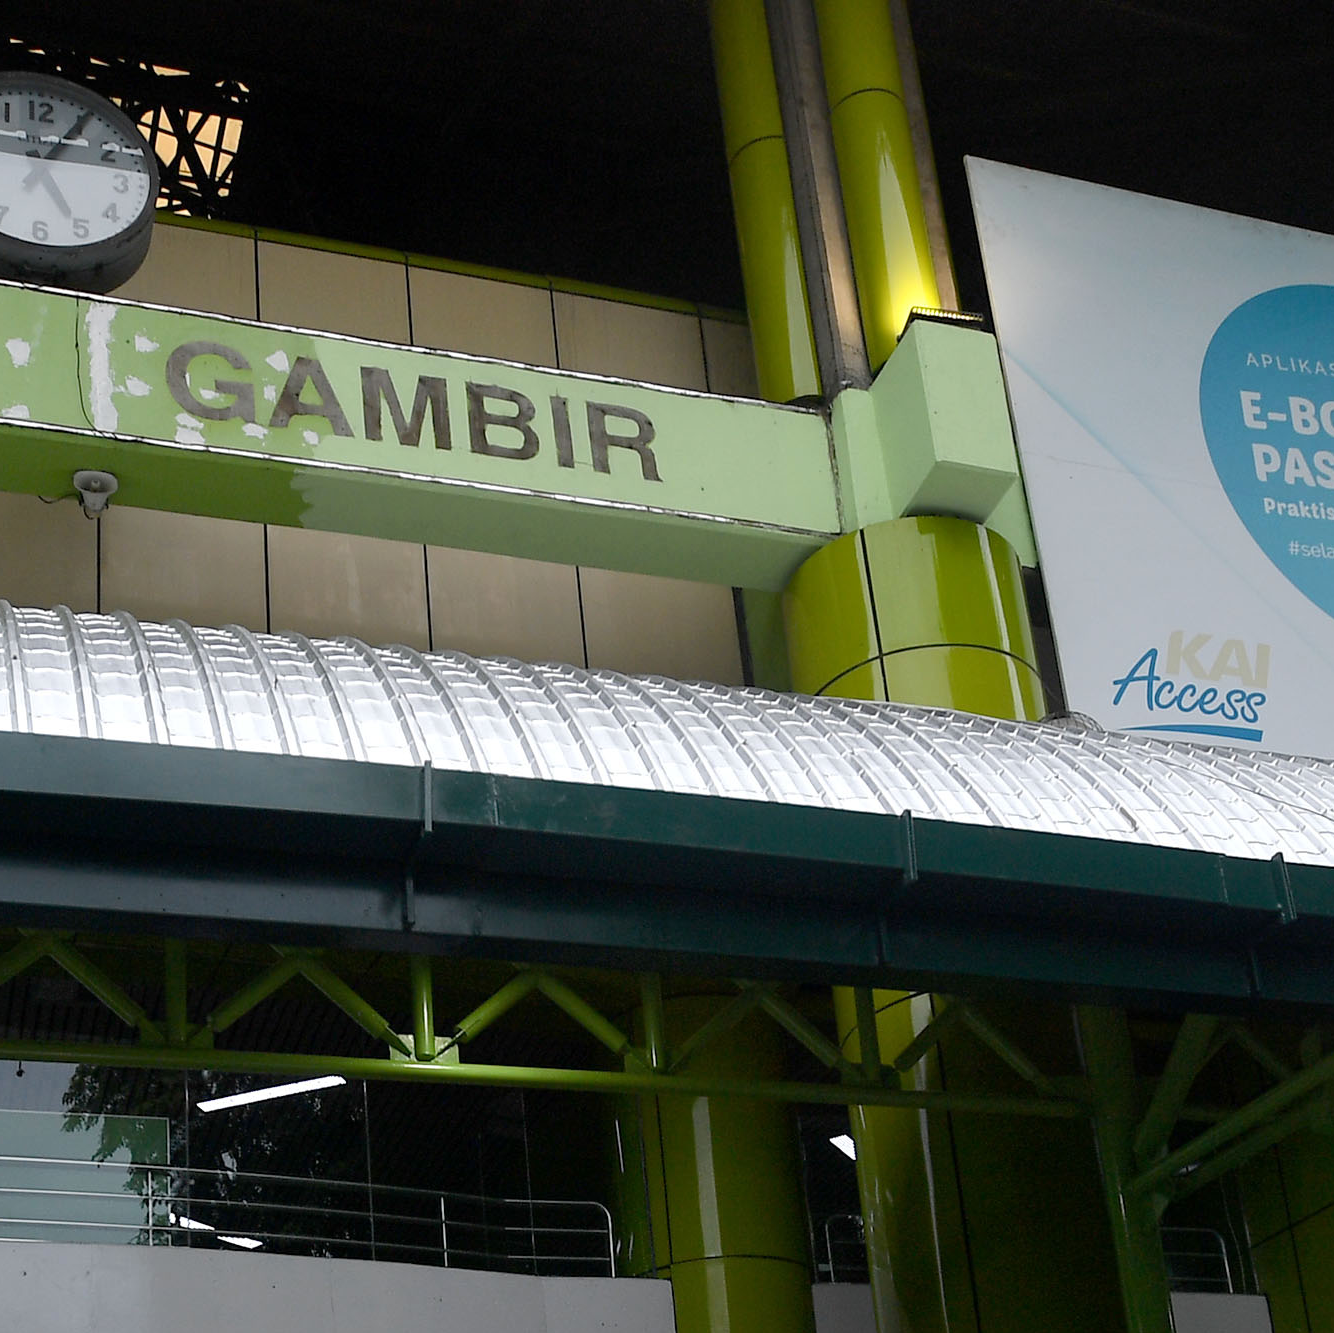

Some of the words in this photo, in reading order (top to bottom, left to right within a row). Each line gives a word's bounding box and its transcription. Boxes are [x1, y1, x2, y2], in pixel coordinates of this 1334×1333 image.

[29, 100, 54, 123] 12
[113, 174, 129, 194] 3
[102, 203, 120, 223] 4
[32, 221, 49, 241] 6
[73, 219, 89, 239] 5
[165, 340, 663, 482] GAMBIR
[1165, 629, 1271, 689] KAI
[1113, 647, 1266, 723] Access
